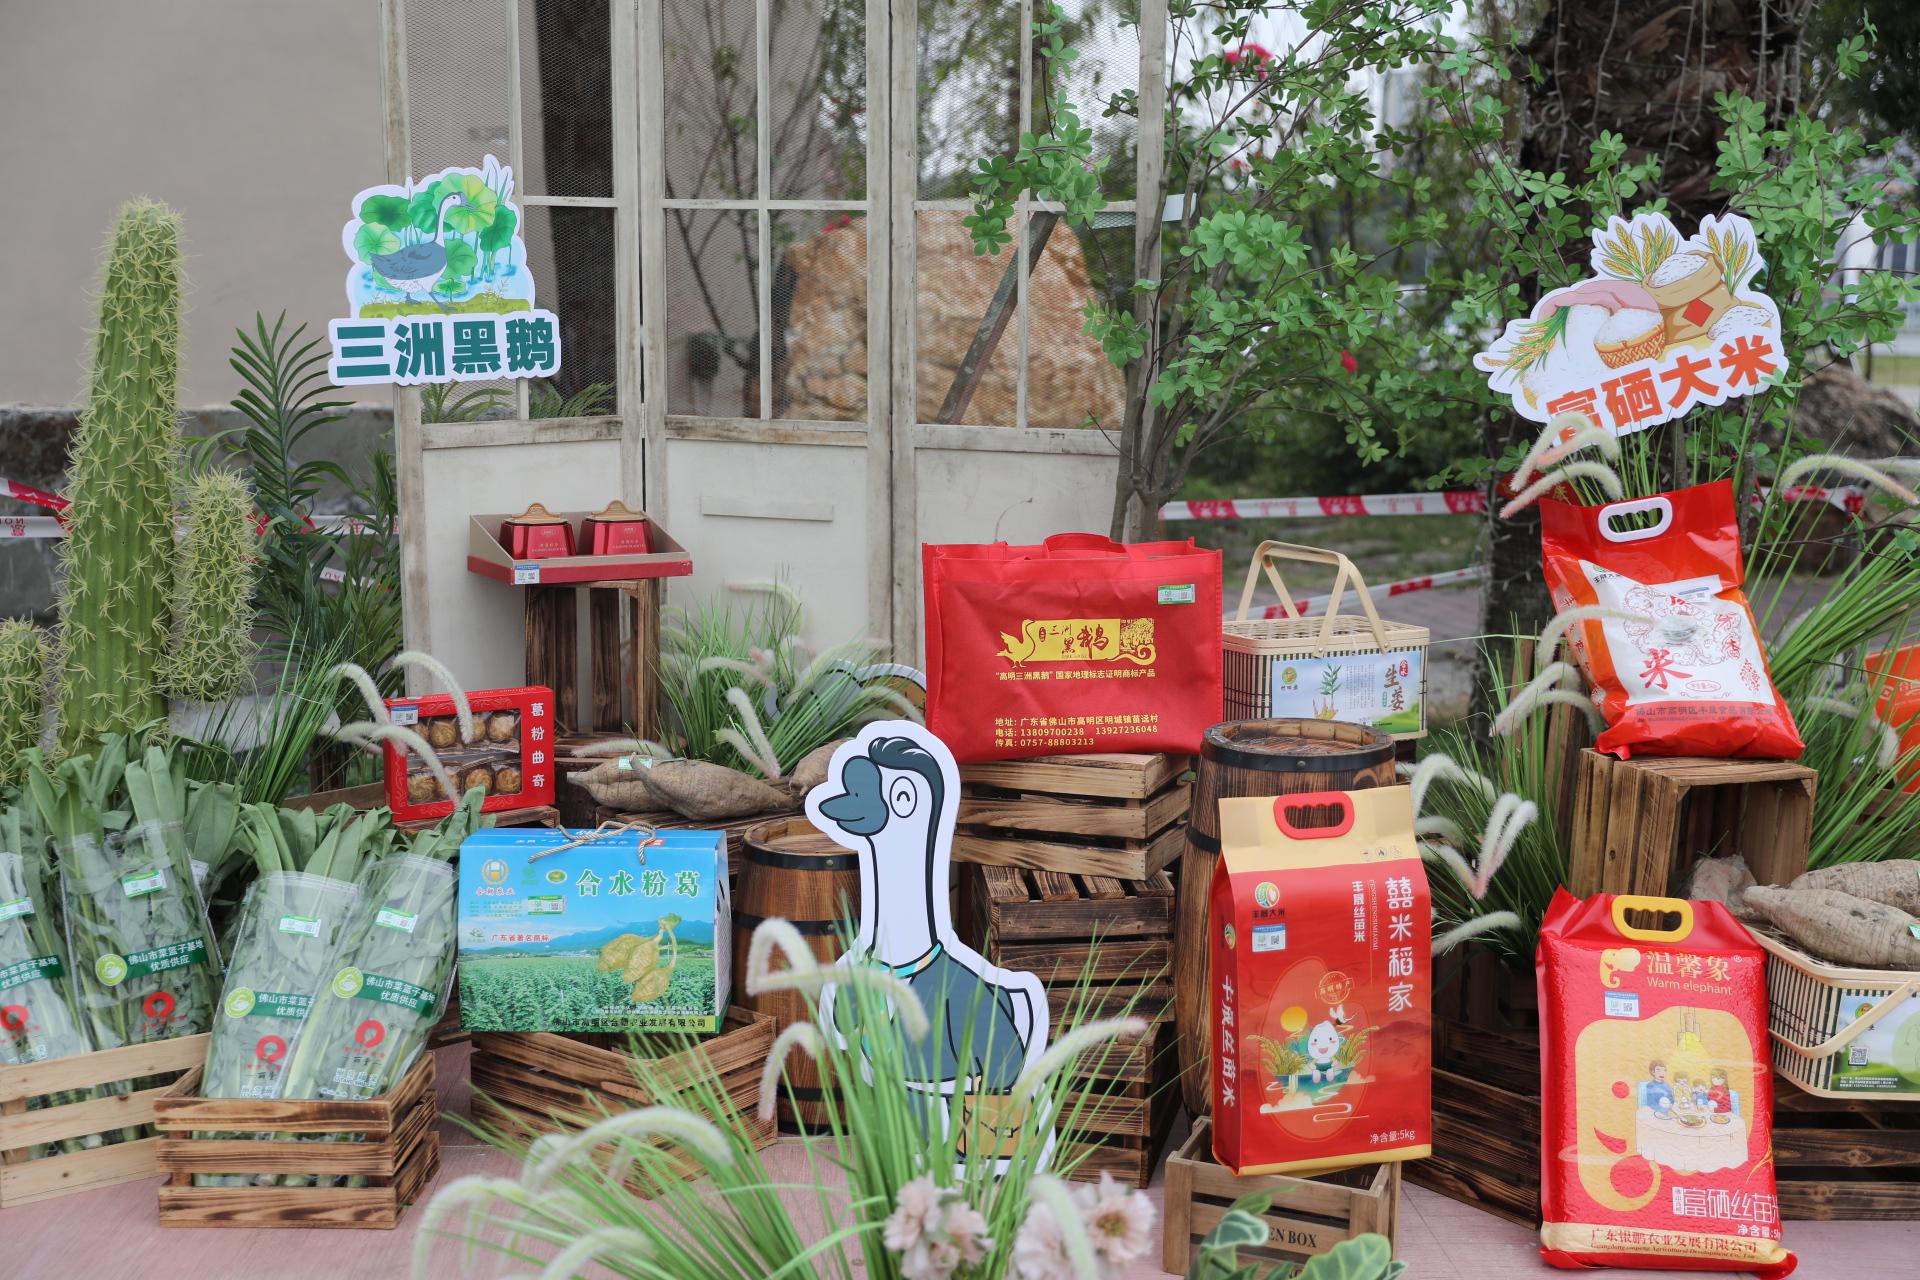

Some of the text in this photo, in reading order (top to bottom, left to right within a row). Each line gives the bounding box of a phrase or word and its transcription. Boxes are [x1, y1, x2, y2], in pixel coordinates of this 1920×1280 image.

[336, 317, 555, 378] 三洲黑鹅
[1096, 725, 1158, 735] 13927236048
[531, 703, 545, 788] 葛粉曲奇
[576, 869, 701, 897] 合水粉葛
[128, 939, 204, 965] 佛山市菜篮子基地
[151, 954, 191, 972] 优质供应
[1646, 951, 1732, 982] 温馨象
[1, 970, 42, 989] 优质供应
[366, 976, 436, 1004] 佛山市菜篮子基地
[1647, 977, 1733, 995] Warm elephant
[380, 990, 417, 1009] 优质供应
[1288, 1230, 1317, 1248] BOX
